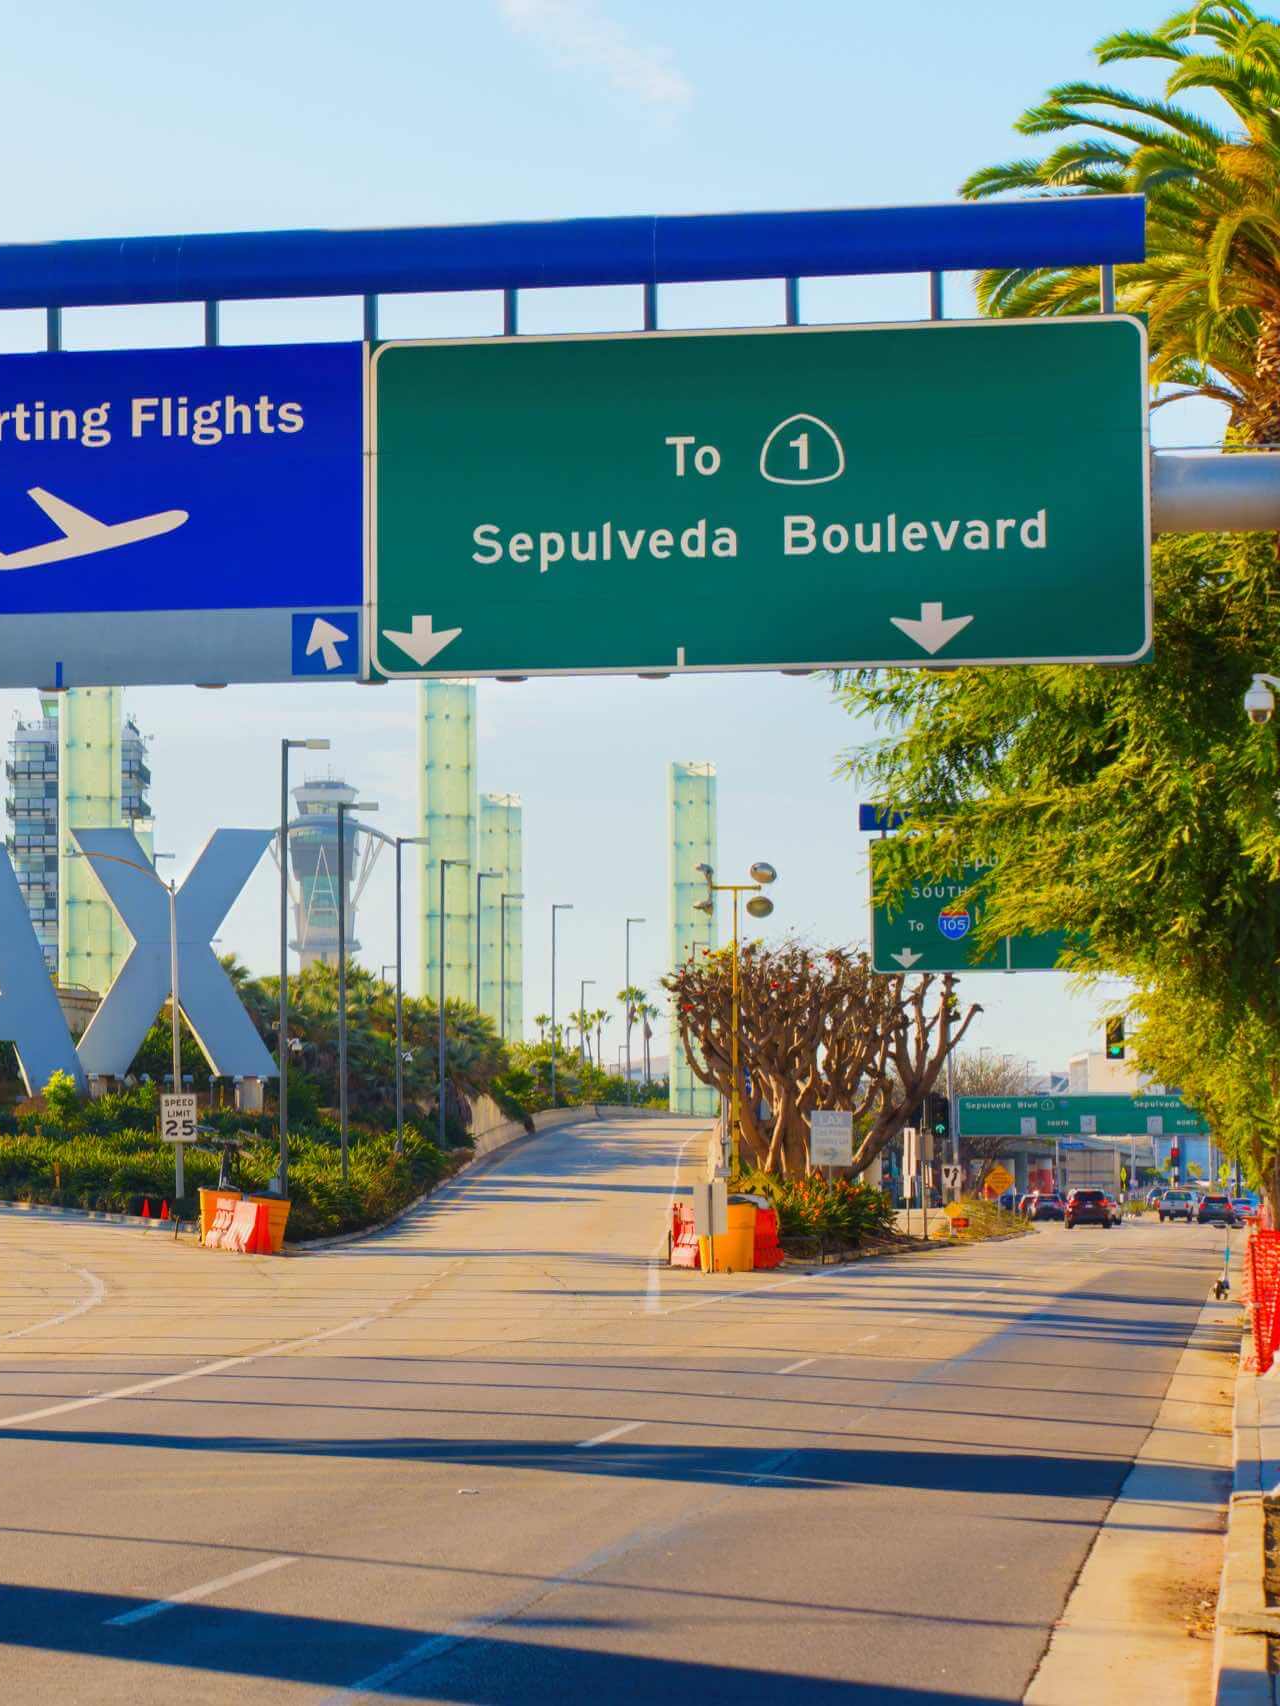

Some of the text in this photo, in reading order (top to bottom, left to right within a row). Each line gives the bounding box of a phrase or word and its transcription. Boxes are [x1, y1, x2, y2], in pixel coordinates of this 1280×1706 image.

[131, 396, 305, 446] Flights
[665, 433, 809, 477] To 1
[472, 509, 1047, 573] Sepulveda Boulevard
[911, 886, 968, 899] SOUTH
[908, 919, 966, 932] To 105
[165, 1099, 194, 1107] SPEED
[167, 1110, 192, 1118] LIMIT
[165, 1120, 194, 1136] 25
